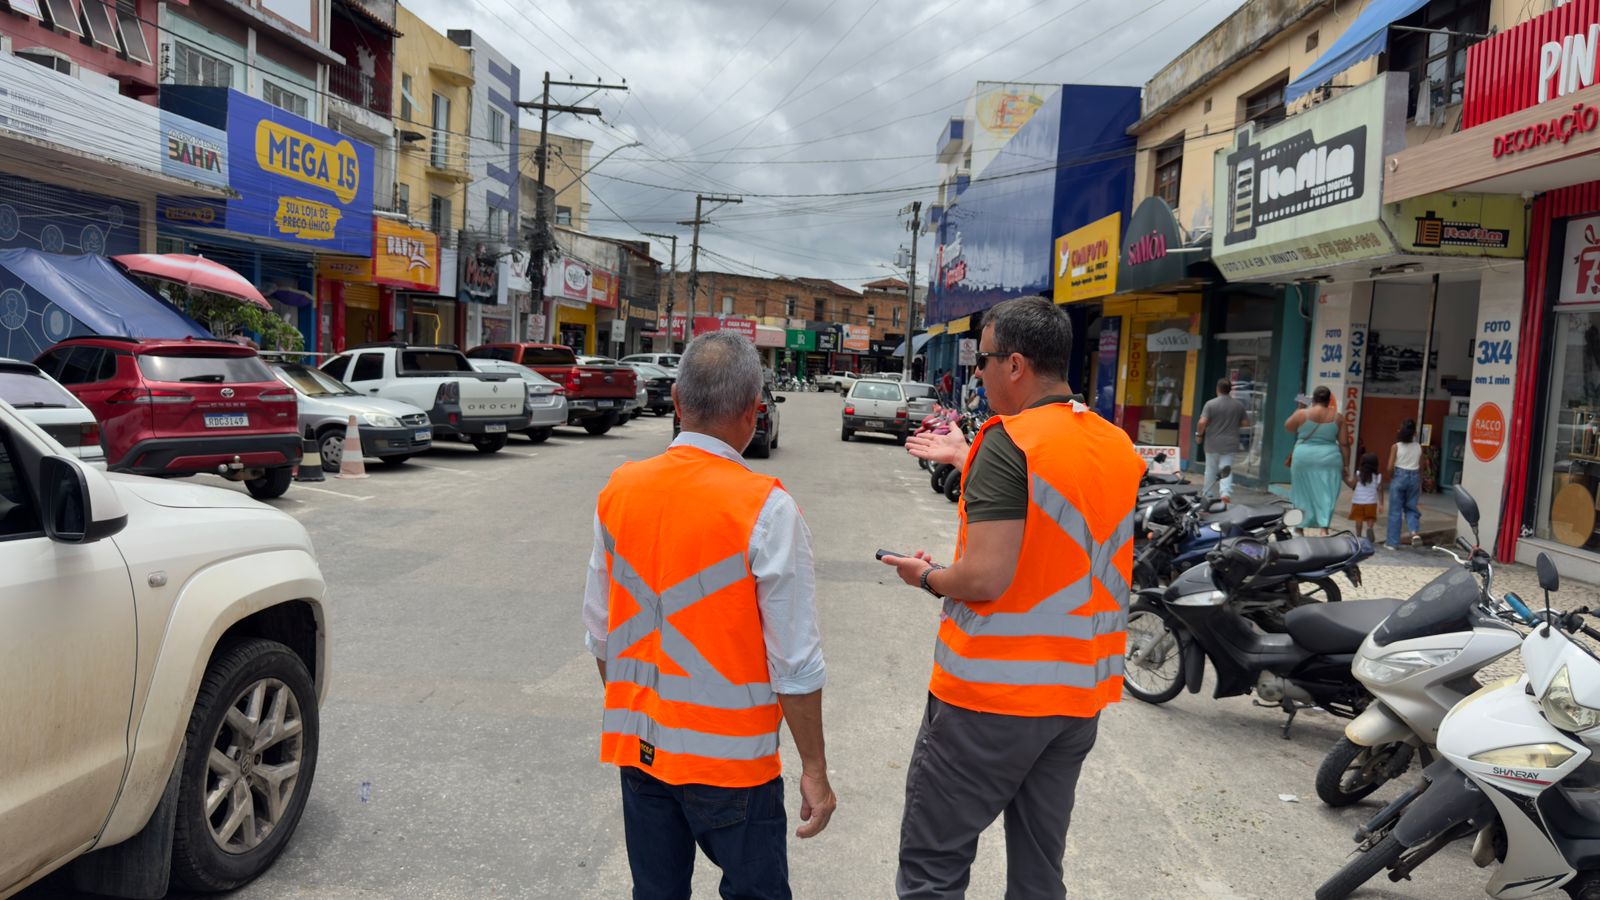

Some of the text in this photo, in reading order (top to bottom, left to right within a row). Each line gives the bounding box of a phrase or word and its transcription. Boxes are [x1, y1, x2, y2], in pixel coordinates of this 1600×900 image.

[1492, 103, 1599, 158] DECORAÇÃO
[168, 137, 221, 174] BAHIA
[268, 129, 356, 189] MEGA 15
[1258, 144, 1355, 204] Itafilm
[1310, 176, 1353, 198] FOTO DIGITAL
[286, 201, 329, 219] SUA LOJA DE
[282, 215, 331, 232] PREÇO ÚNICO
[1443, 227, 1503, 240] Itafilm
[1222, 260, 1240, 273] FOTO
[1271, 250, 1299, 265] MINUTO
[1325, 329, 1342, 339] FOTO
[1484, 320, 1511, 333] FOTO
[1321, 344, 1342, 363] 3X4
[1477, 340, 1512, 365] 3X4
[1475, 375, 1510, 385] em 1 min
[1475, 419, 1501, 431] RACCO
[1493, 766, 1540, 780] SHINERAY
